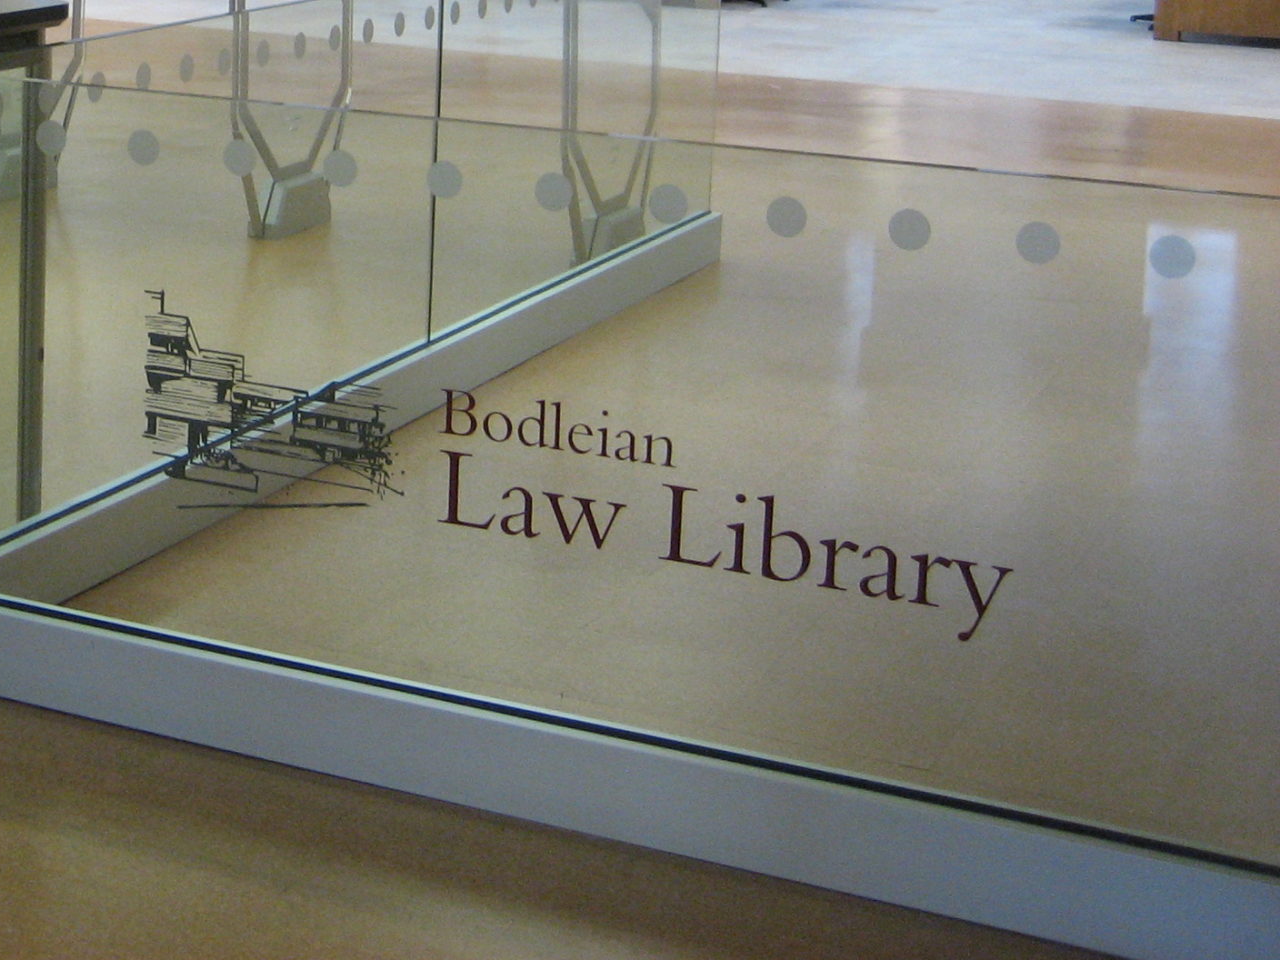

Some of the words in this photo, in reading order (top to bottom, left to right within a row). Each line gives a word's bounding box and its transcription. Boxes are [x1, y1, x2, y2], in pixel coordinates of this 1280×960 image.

[439, 389, 677, 468] Bodleian
[437, 449, 628, 551] Law
[659, 483, 1015, 644] Library
